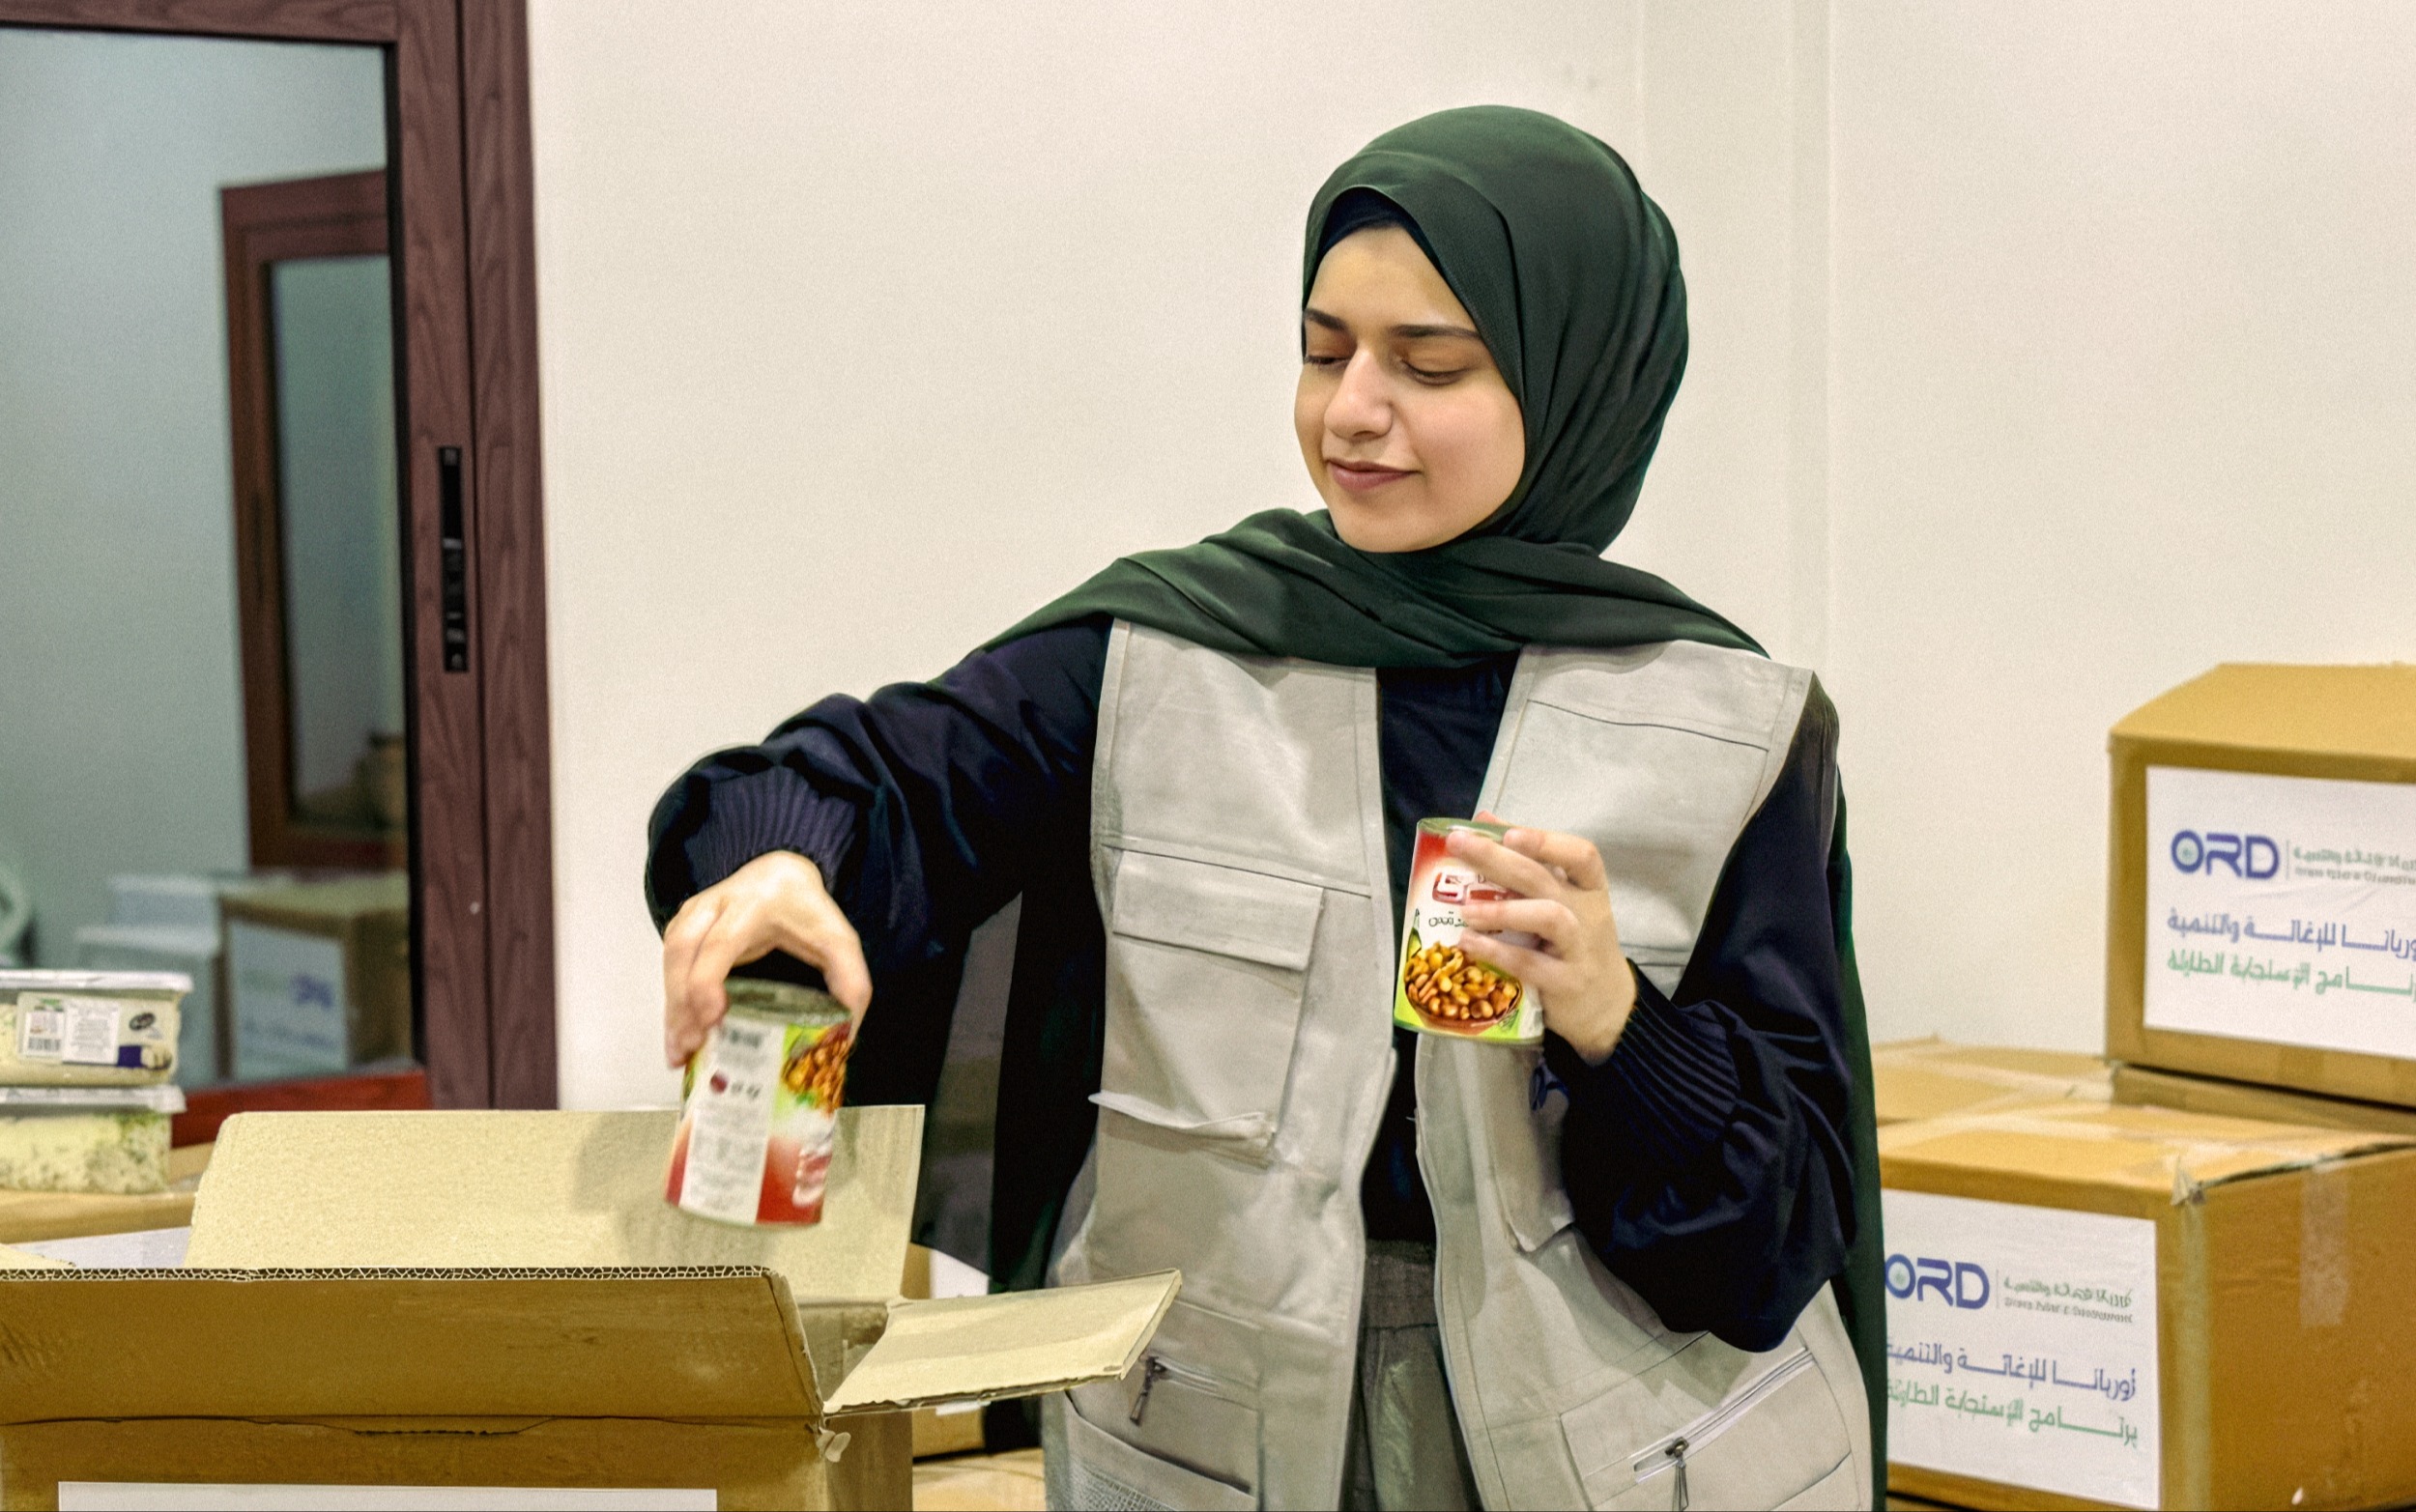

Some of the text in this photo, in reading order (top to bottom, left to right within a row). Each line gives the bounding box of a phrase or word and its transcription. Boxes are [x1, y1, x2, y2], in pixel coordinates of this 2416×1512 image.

[2171, 829, 2280, 880] ORD
[2167, 907, 2240, 943] والتنمية
[1884, 1253, 1990, 1310] ORD
[2029, 1406, 2138, 1448] برنامج
